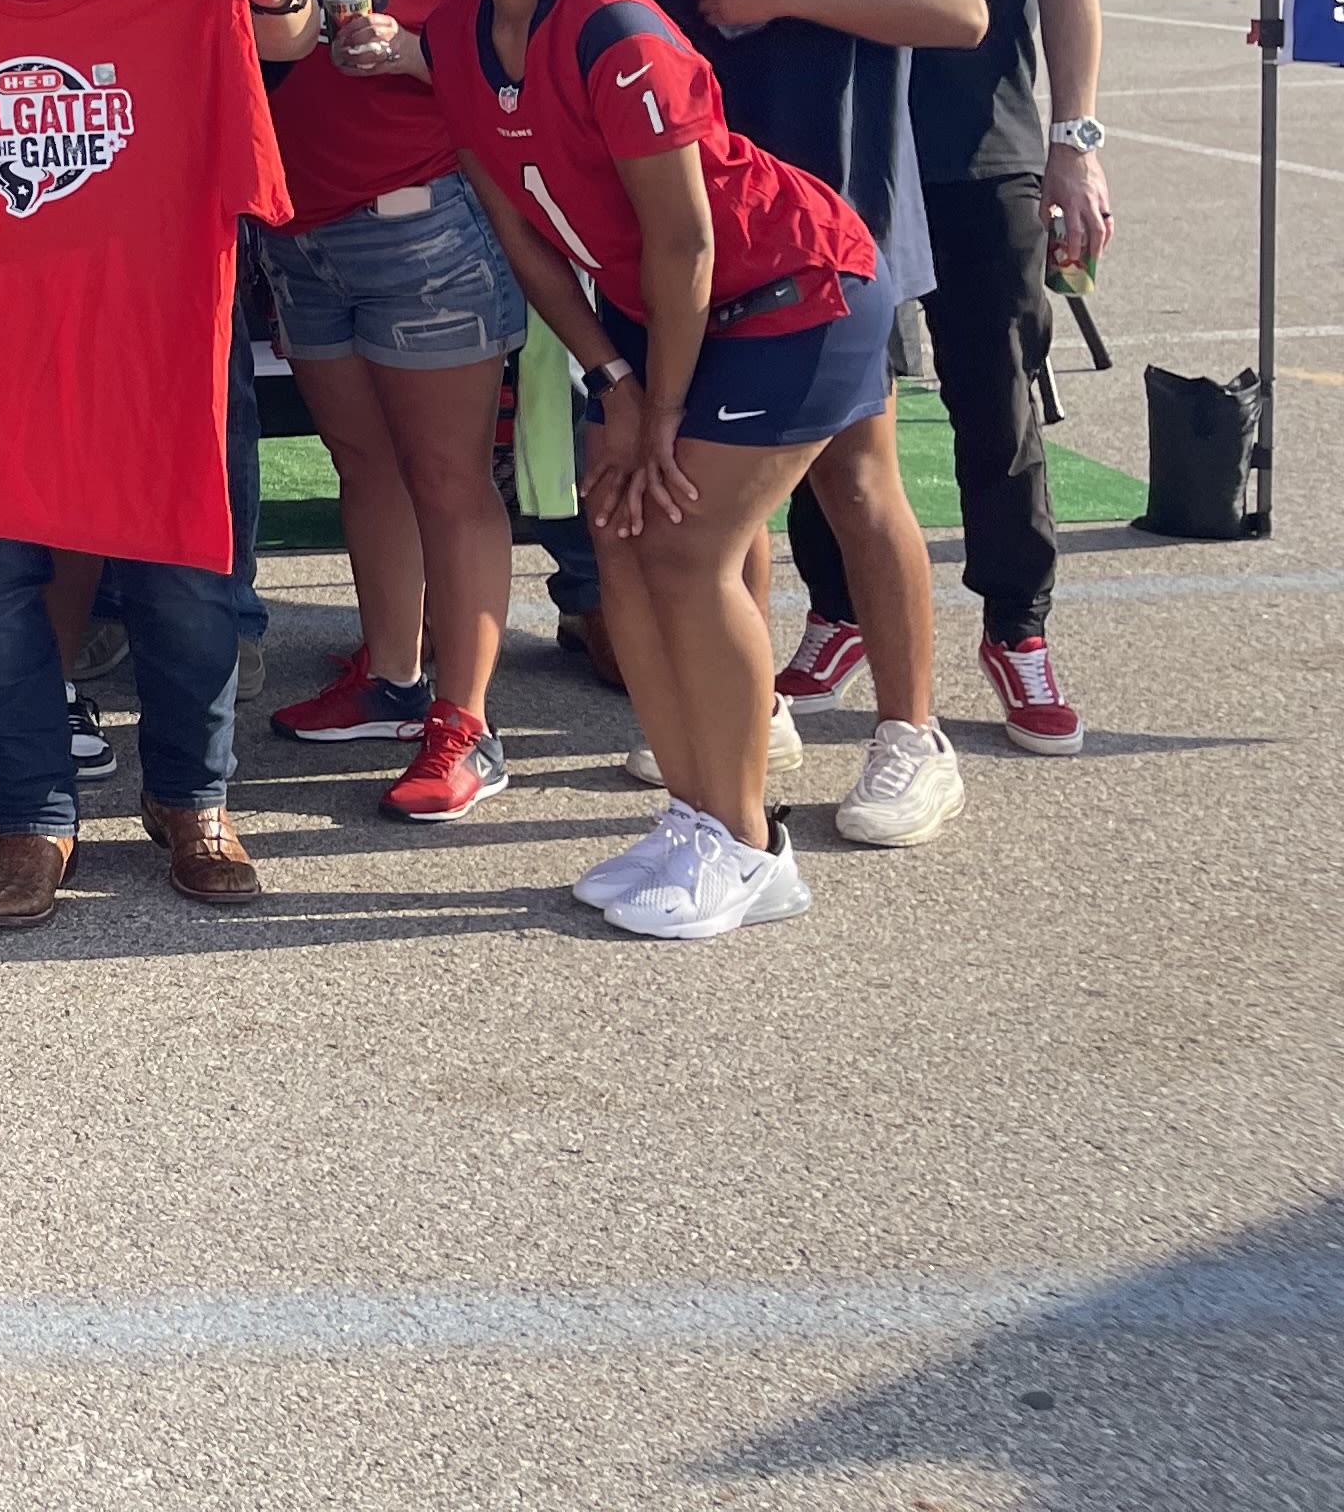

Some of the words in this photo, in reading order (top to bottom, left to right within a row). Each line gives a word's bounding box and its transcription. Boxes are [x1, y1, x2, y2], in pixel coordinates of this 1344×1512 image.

[642, 89, 665, 135] 1
[20, 133, 108, 168] GAME
[523, 165, 603, 269] 1
